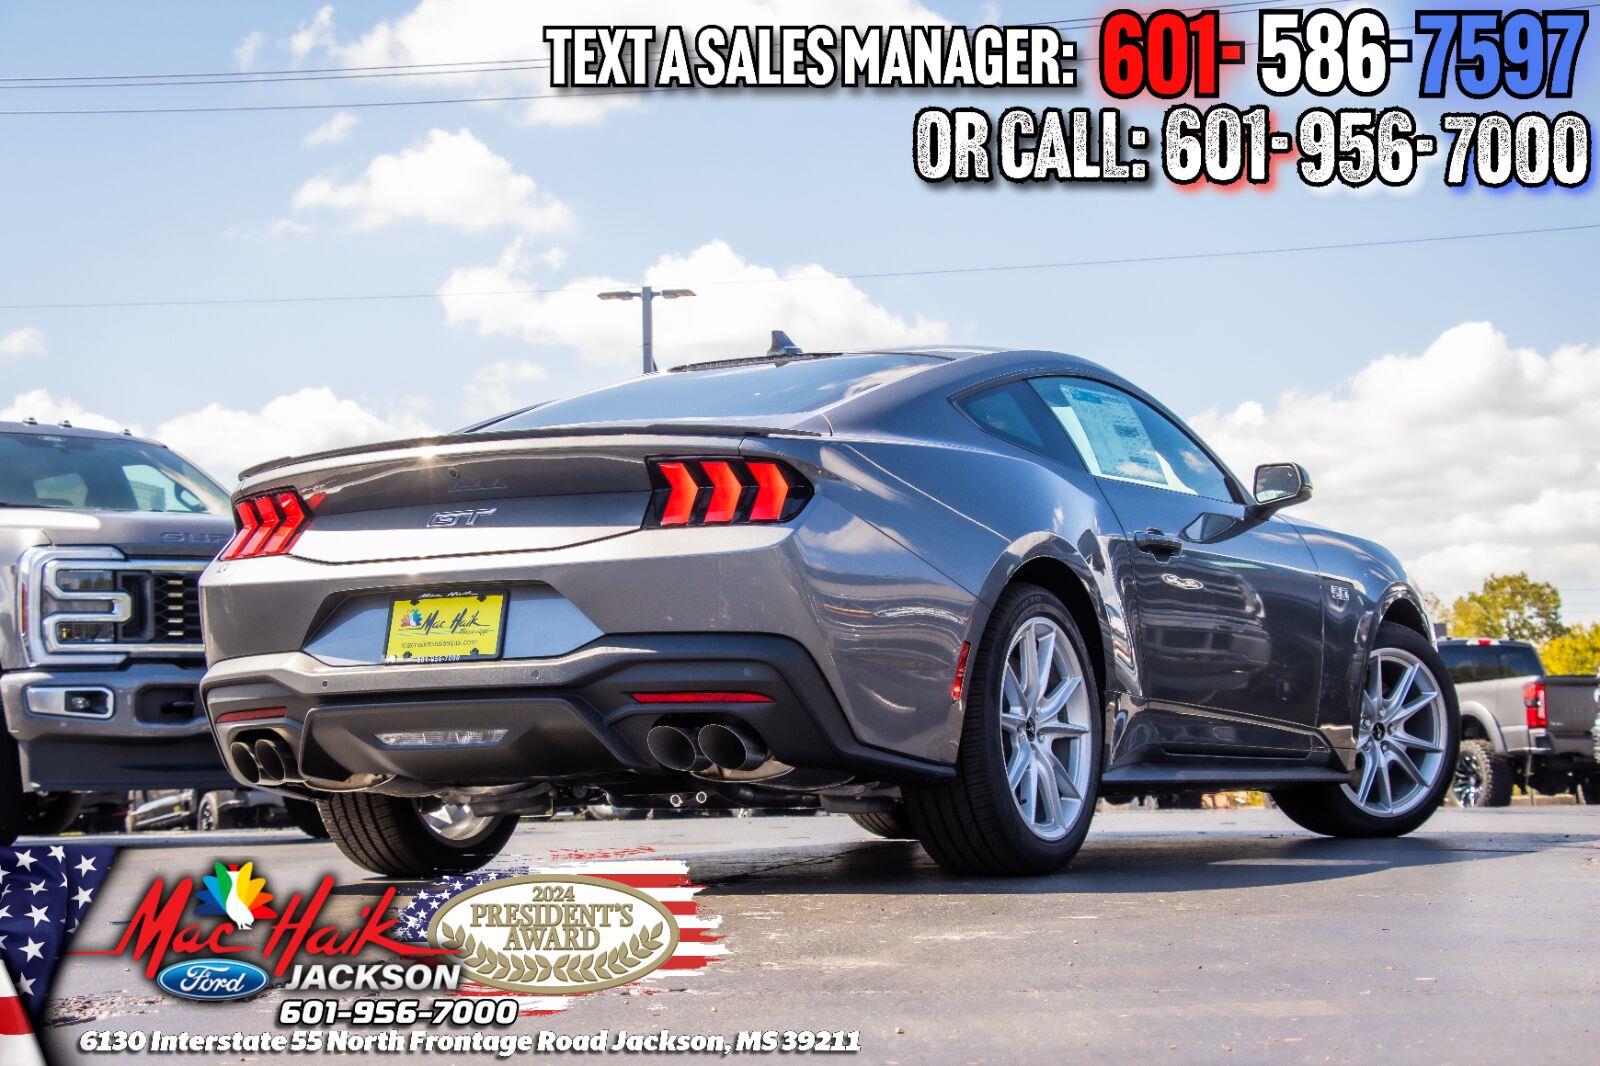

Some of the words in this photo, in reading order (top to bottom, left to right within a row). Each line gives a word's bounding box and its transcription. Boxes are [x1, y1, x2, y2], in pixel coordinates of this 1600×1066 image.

[426, 507, 497, 528] GT
[421, 610, 446, 635] Mac
[449, 608, 490, 634] Haik
